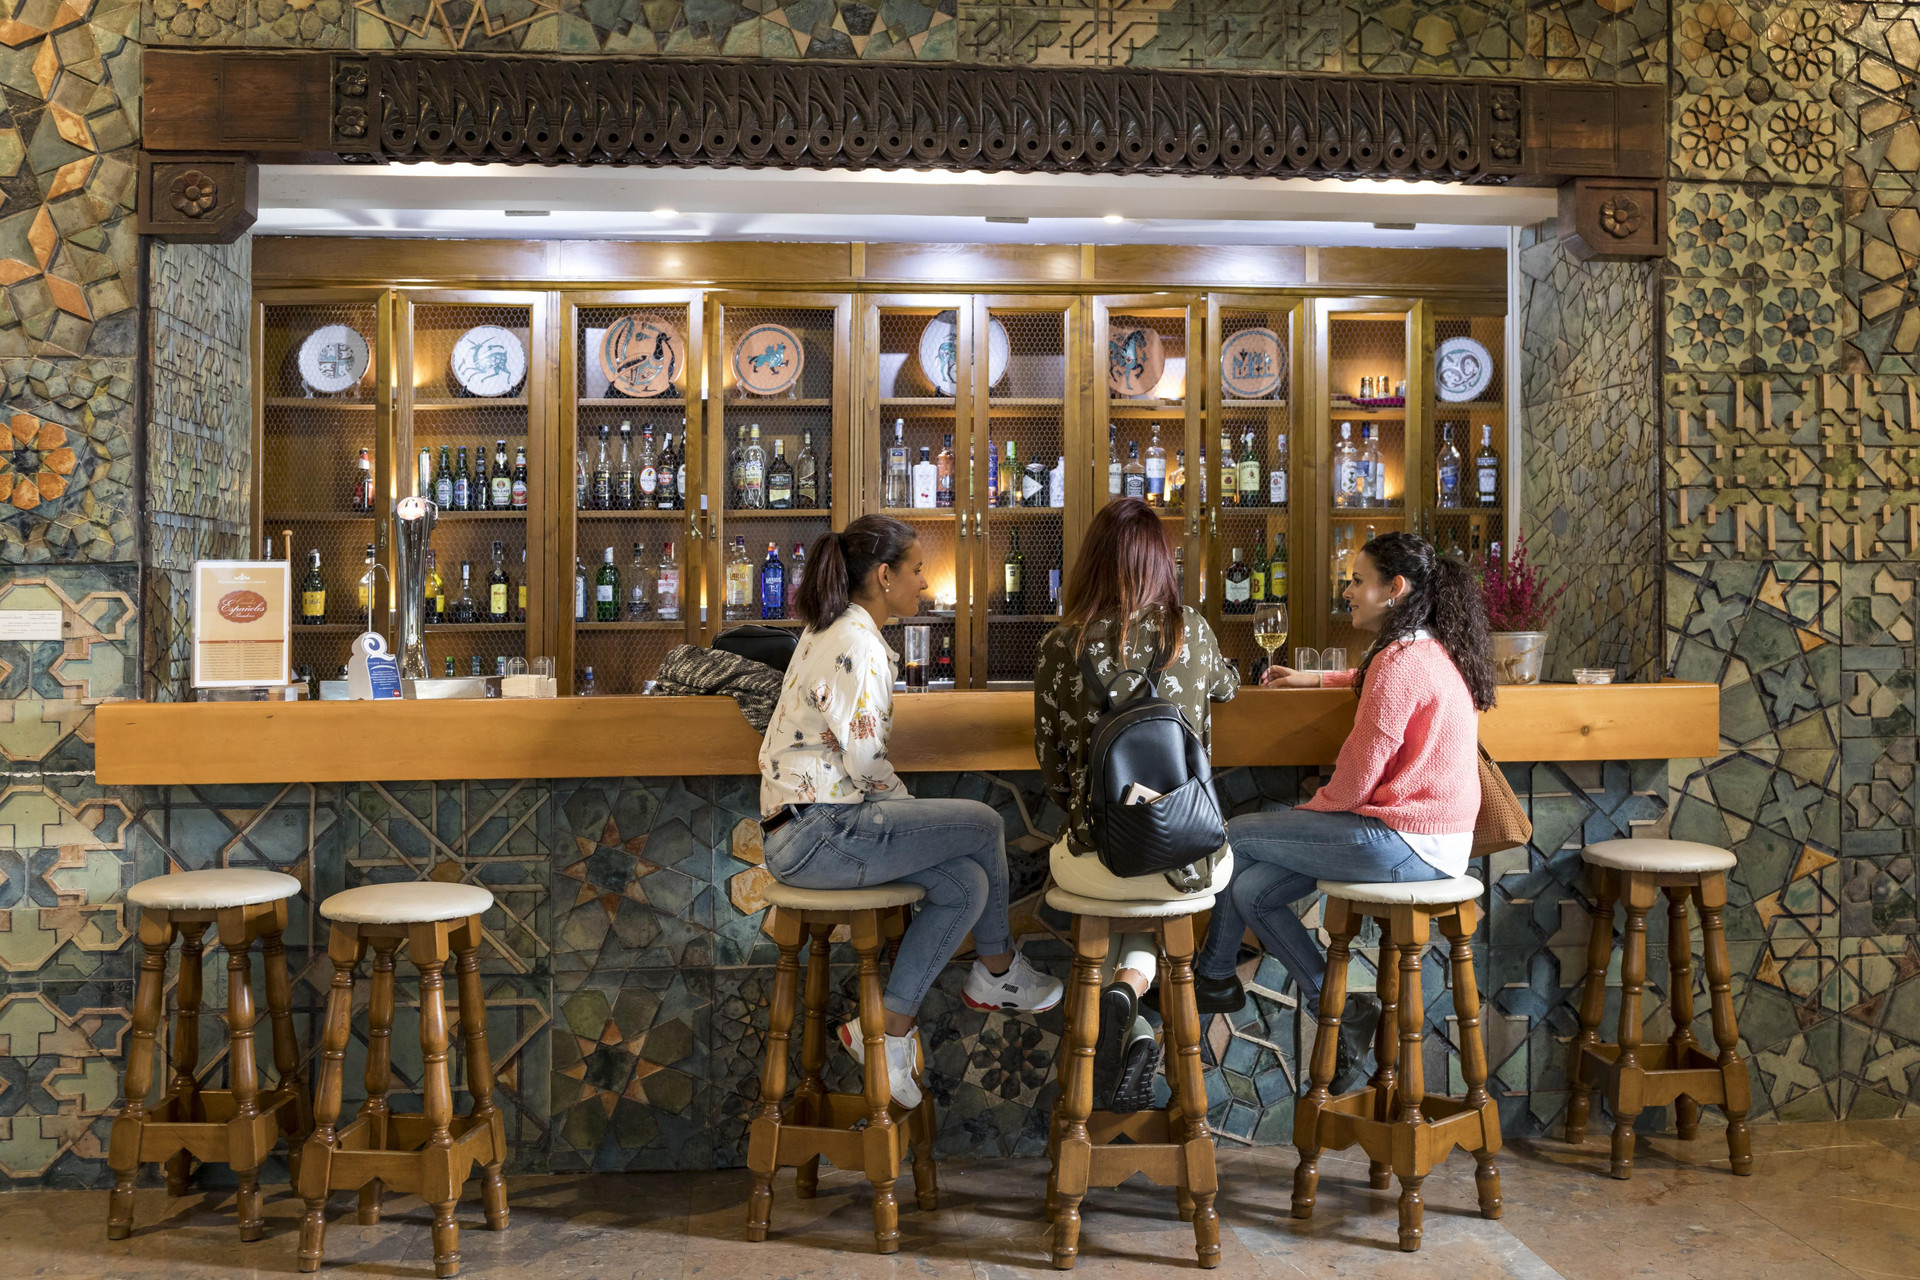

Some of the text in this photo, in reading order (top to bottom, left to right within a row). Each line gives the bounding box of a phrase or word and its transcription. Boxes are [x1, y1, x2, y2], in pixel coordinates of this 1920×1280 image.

[730, 572, 749, 581] LARIOS
[221, 599, 265, 616] Españoles
[1001, 983, 1019, 994] PUMA
